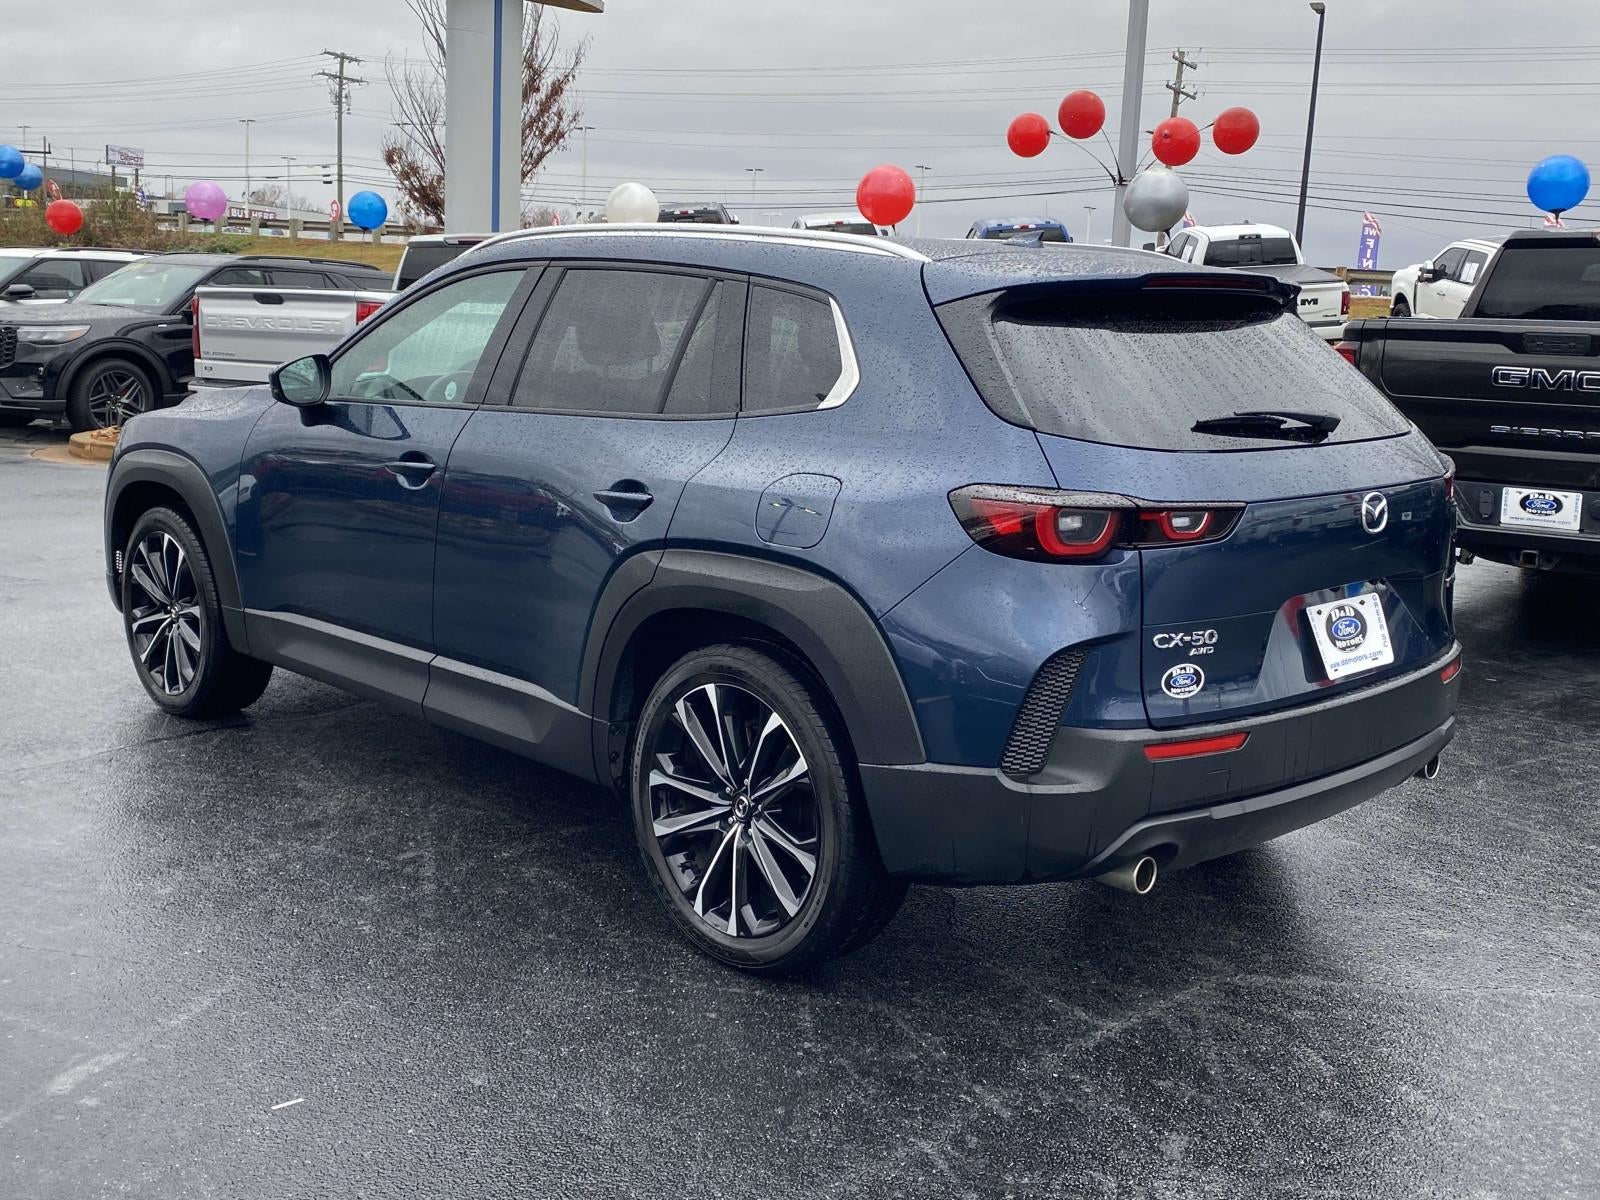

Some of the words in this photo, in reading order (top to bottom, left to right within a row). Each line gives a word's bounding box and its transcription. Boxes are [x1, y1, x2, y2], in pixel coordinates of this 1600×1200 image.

[205, 315, 343, 332] CHEVROLET
[1530, 500, 1551, 509] Ford
[1331, 605, 1355, 622] D&D
[1337, 619, 1356, 636] Ford
[1153, 629, 1218, 649] CX-50
[1334, 633, 1364, 649] MOTORS
[1188, 646, 1214, 657] AWD
[1175, 675, 1192, 686] Ford
